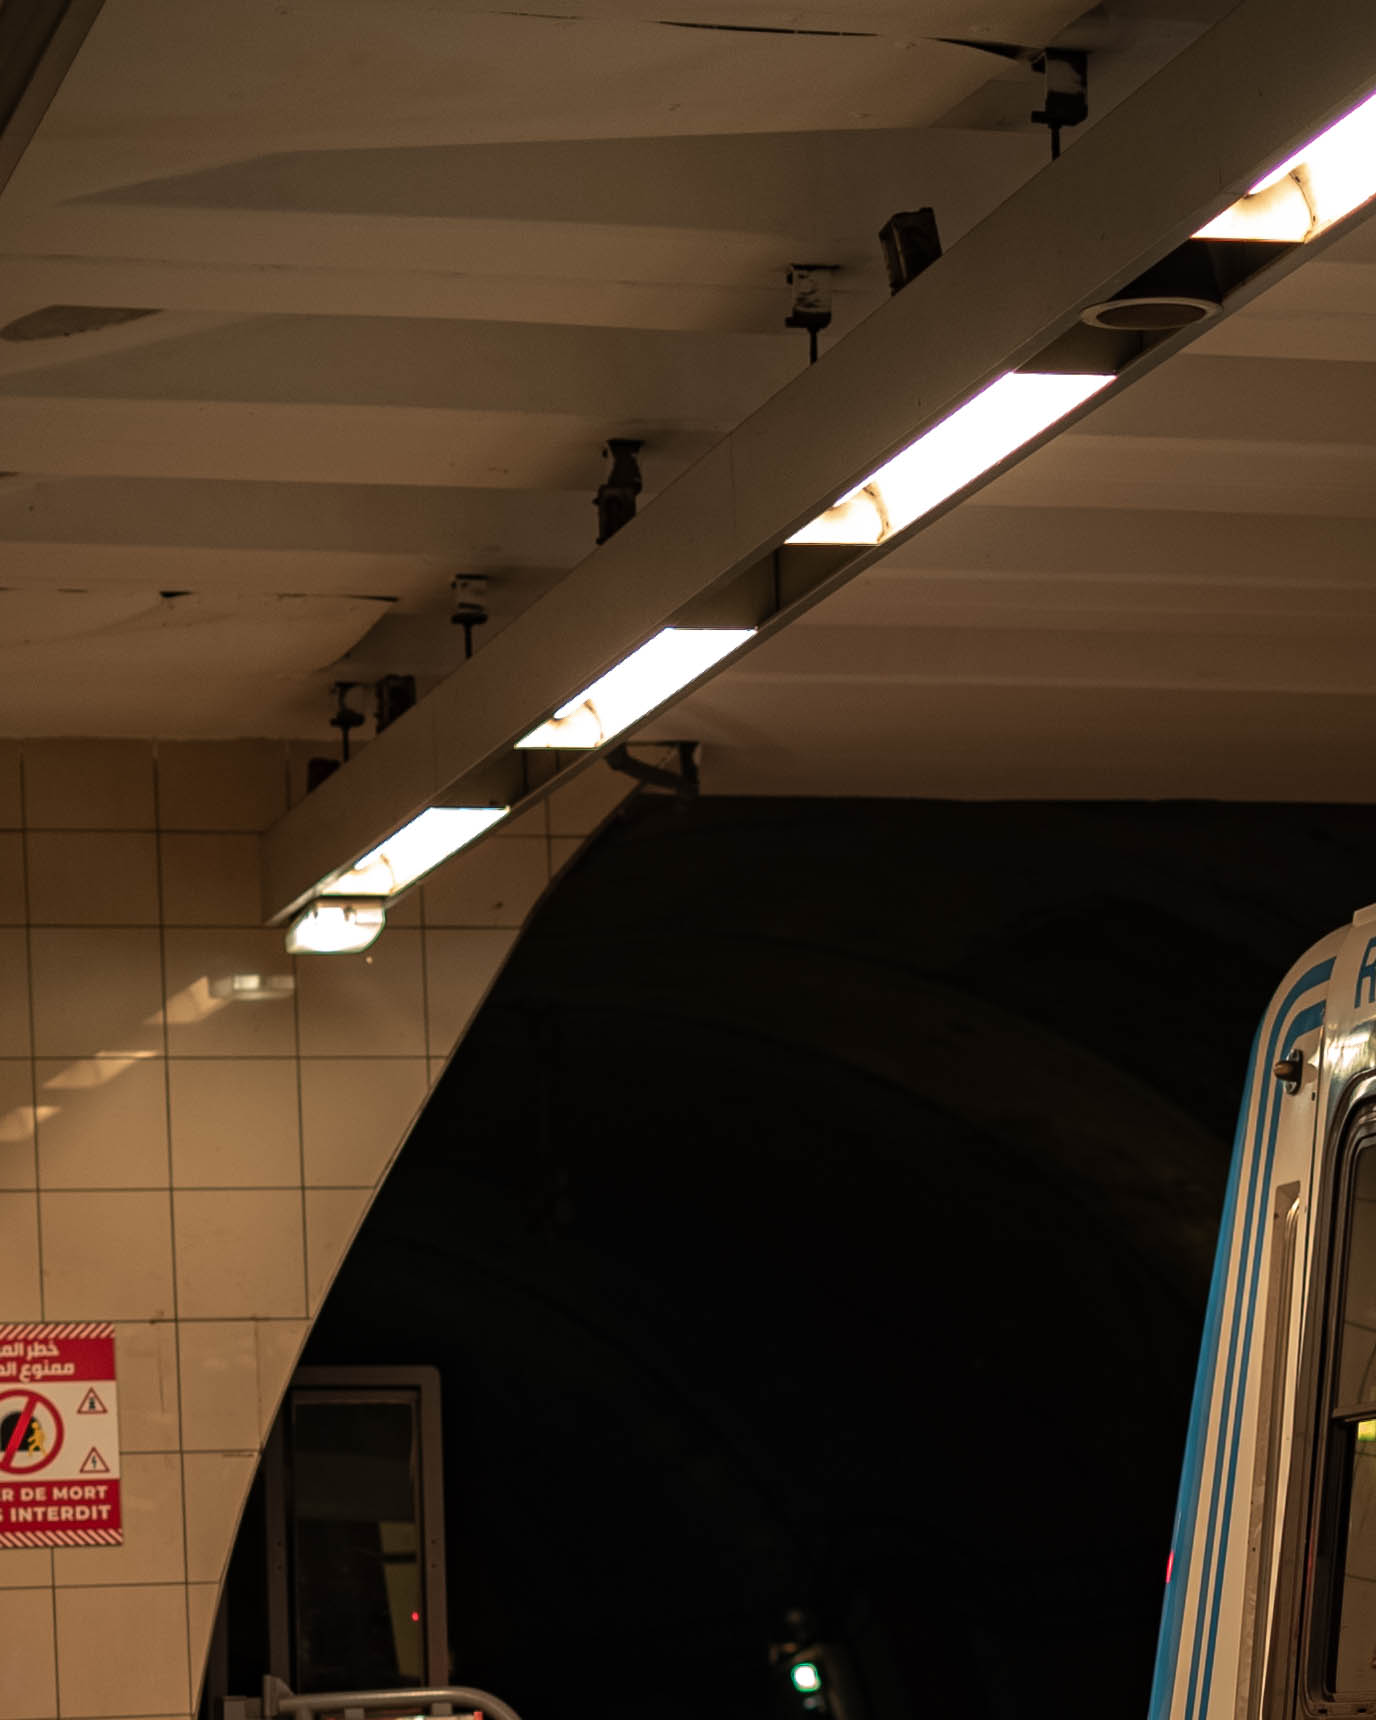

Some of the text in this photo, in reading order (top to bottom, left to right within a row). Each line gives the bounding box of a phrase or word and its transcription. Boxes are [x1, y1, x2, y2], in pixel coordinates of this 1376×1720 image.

[26, 1339, 60, 1361] خطر
[19, 1359, 75, 1383] ممنوع
[20, 1486, 47, 1502] DE
[52, 1485, 108, 1501] MORT
[10, 1504, 112, 1523] INTERDIT
